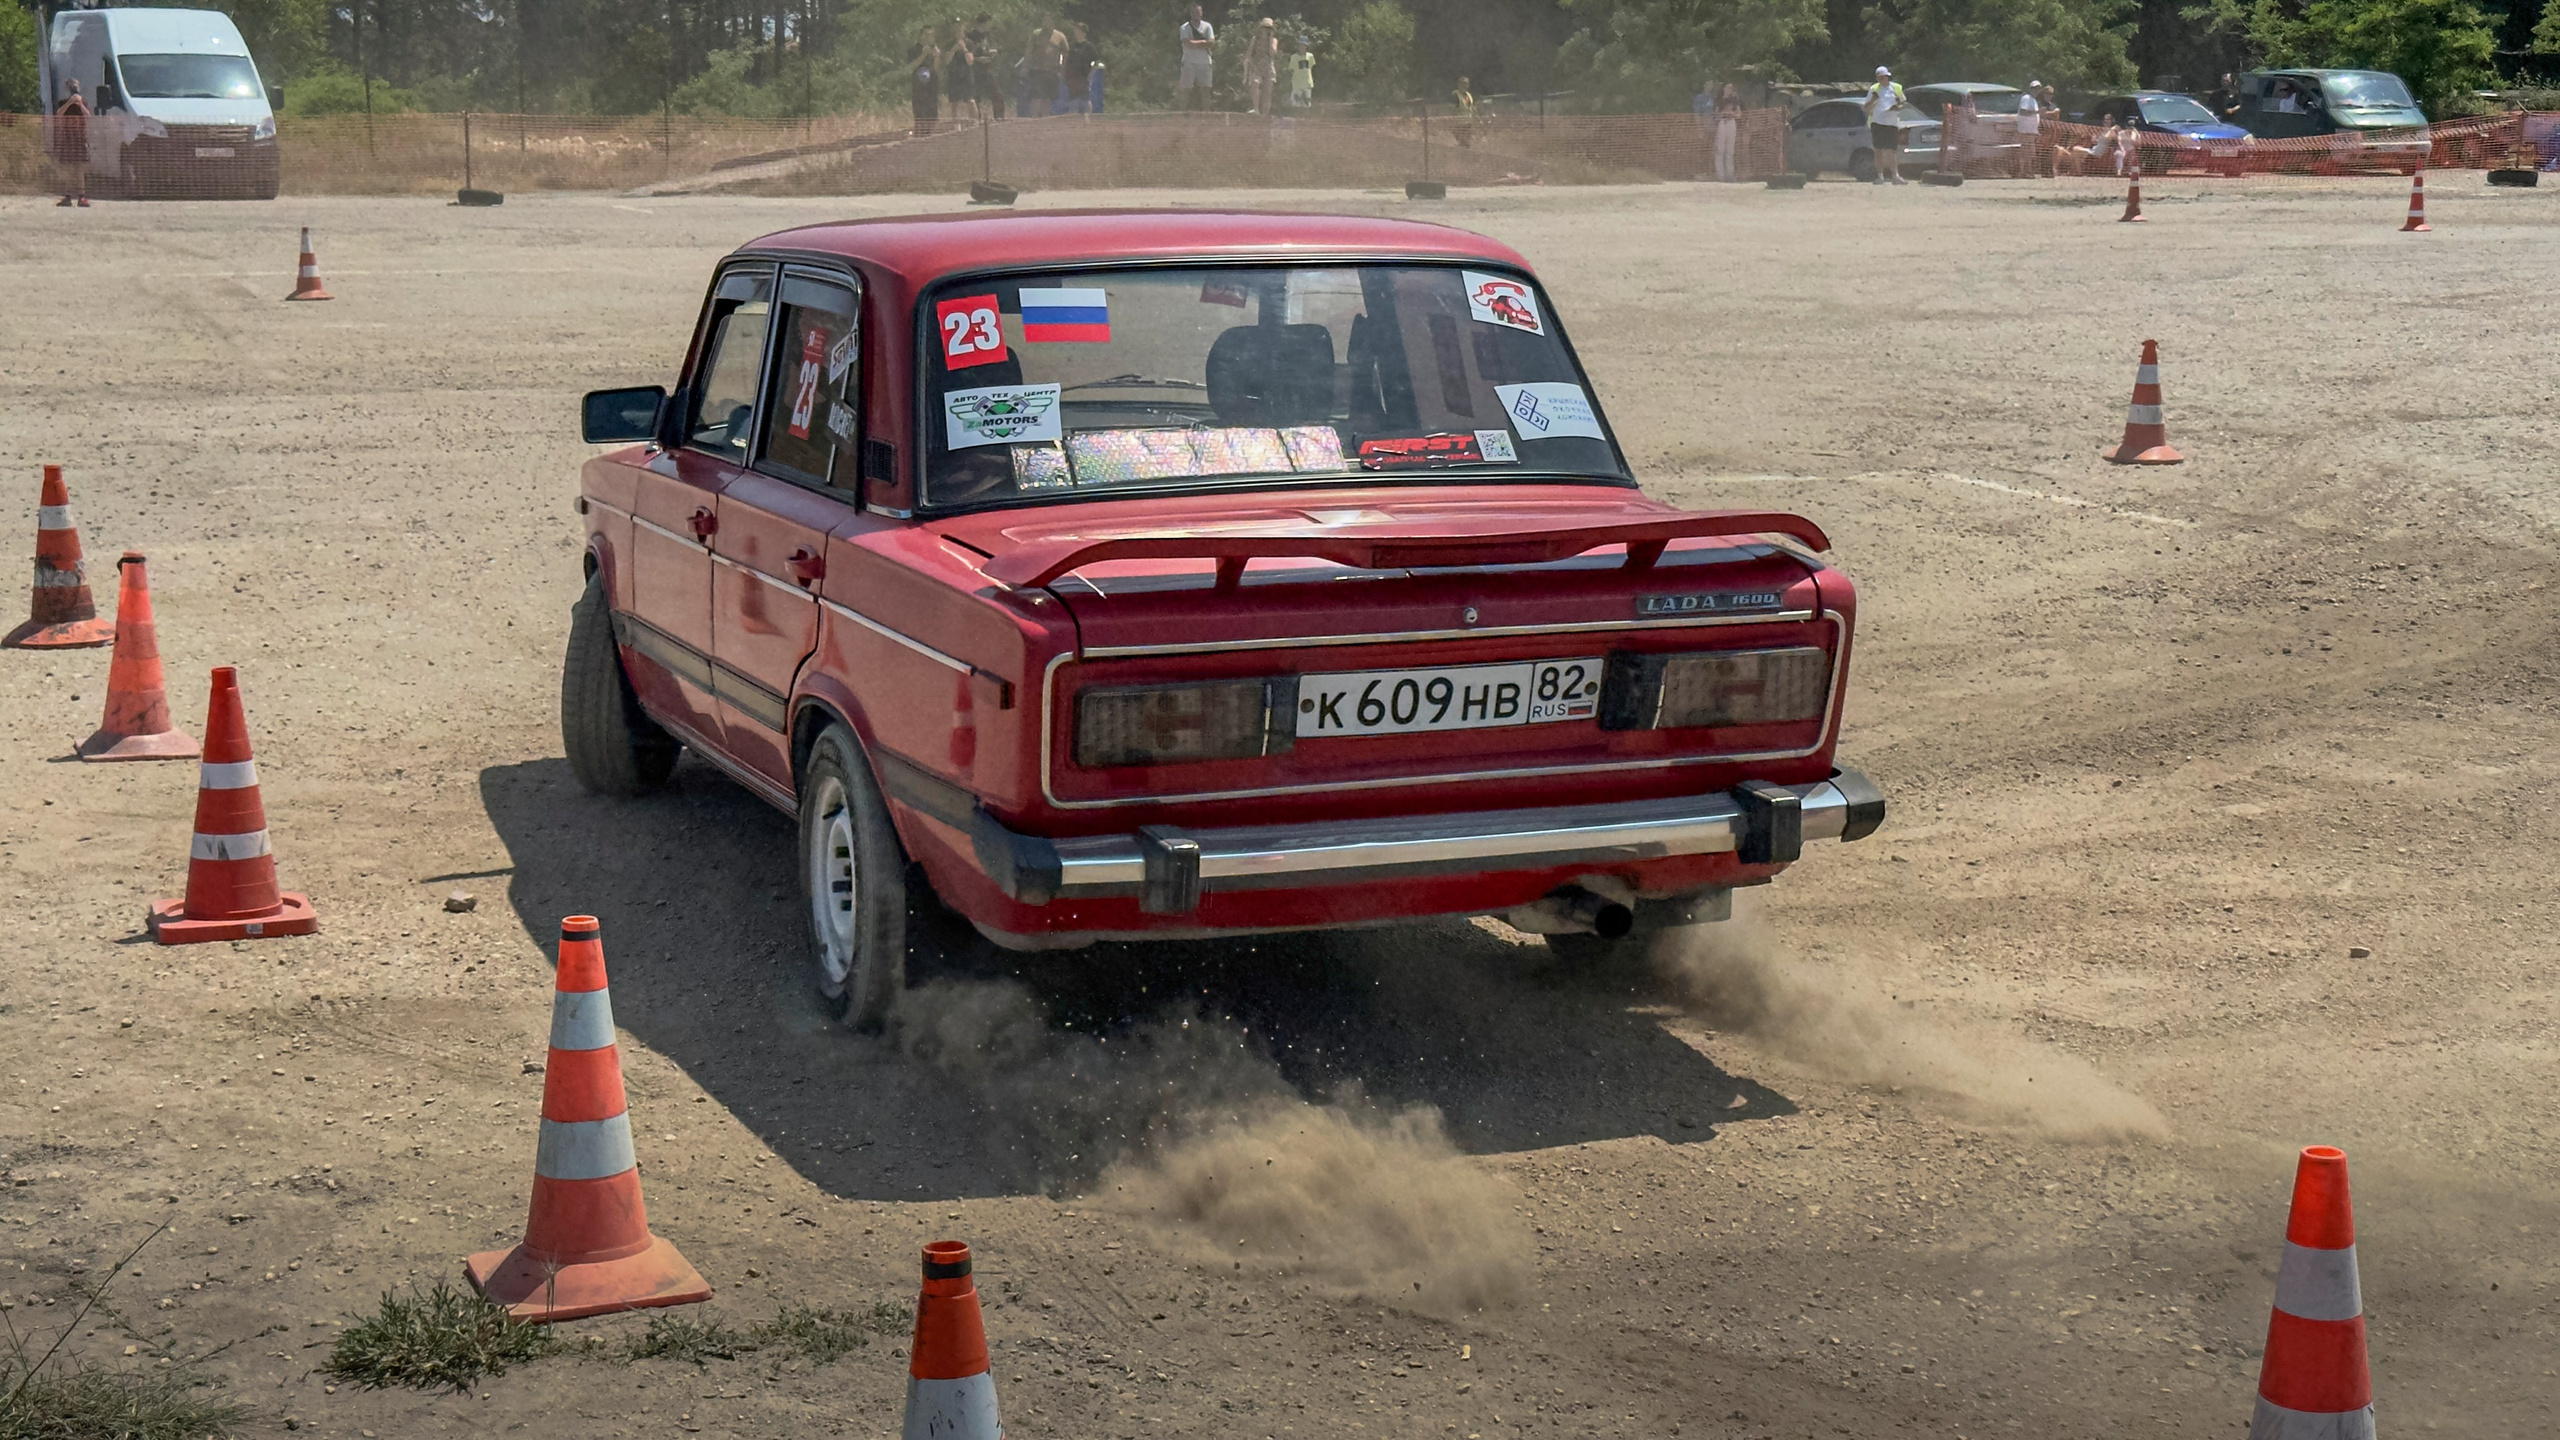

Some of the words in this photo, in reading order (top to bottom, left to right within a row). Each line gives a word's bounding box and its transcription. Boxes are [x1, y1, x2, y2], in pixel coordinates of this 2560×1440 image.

[944, 308, 1001, 356] 23
[792, 360, 819, 430] 23
[953, 395, 978, 403] АВТО
[1647, 596, 1716, 611] LADA
[1732, 594, 1775, 605] 1600
[1538, 665, 1586, 702] 82
[1532, 703, 1567, 718] RUS
